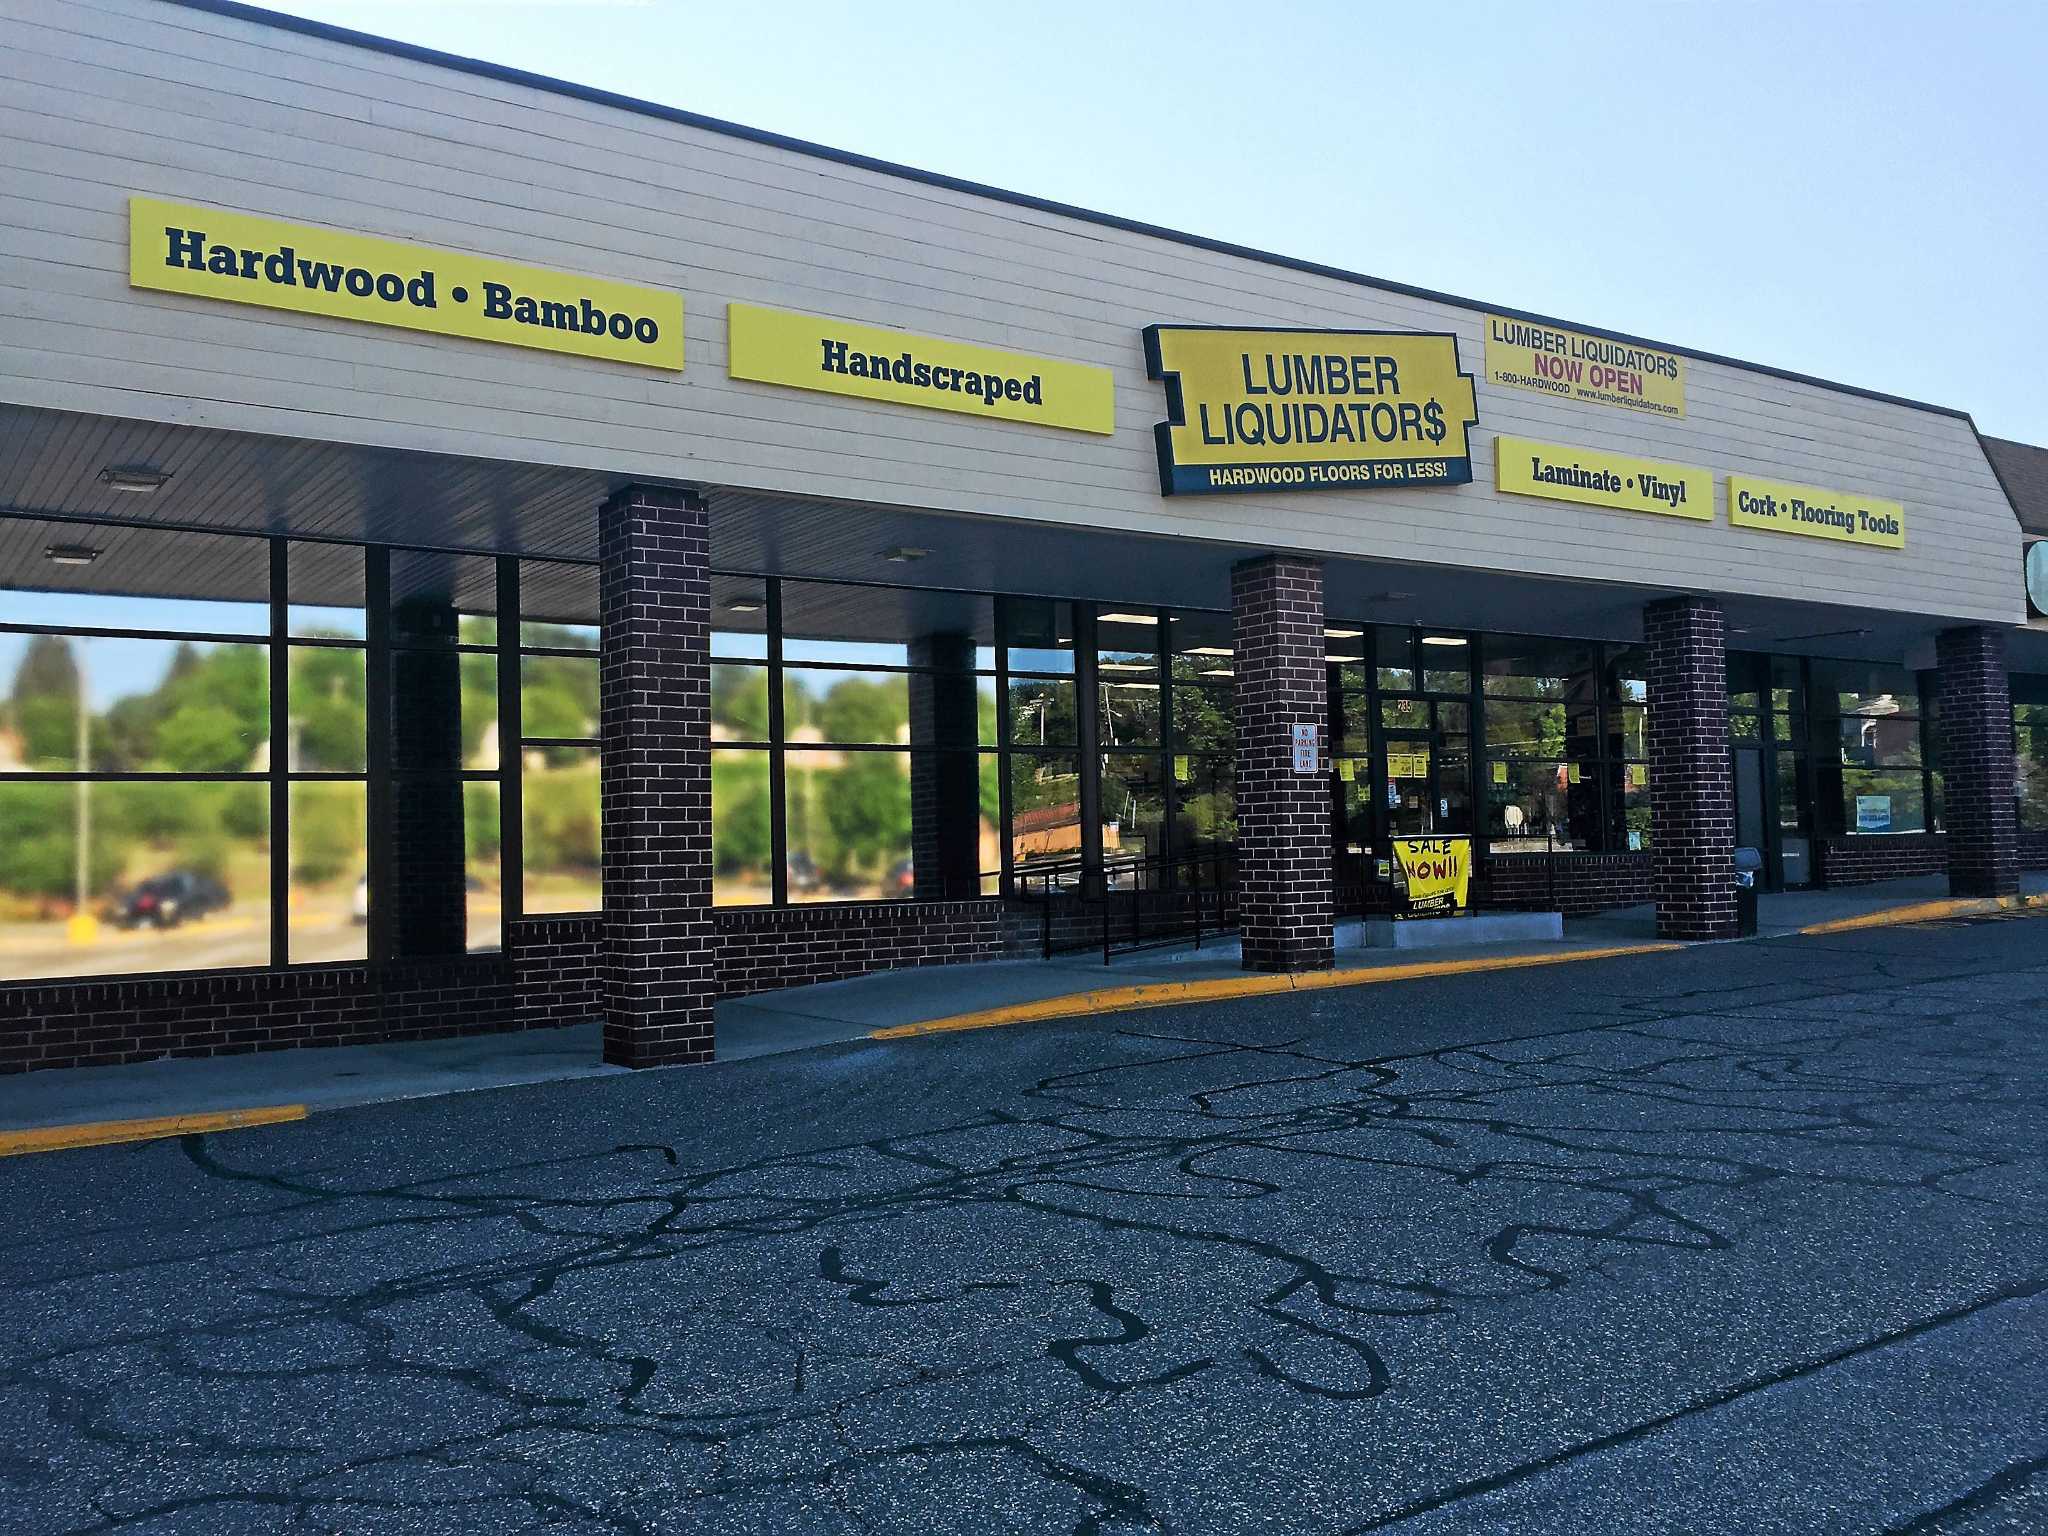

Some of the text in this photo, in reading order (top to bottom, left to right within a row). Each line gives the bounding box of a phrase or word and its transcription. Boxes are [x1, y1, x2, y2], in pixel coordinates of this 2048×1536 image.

[165, 226, 659, 344] Hardwood Bamboo
[1492, 319, 1678, 380] LUMBER LIQUIDATOR$
[821, 339, 1043, 406] Handscraped
[1241, 353, 1400, 396] LUMBER
[1494, 371, 1679, 415] 1-800-HARDWOOD www.lumberliquidators.com
[1534, 352, 1643, 396] NOW OPEN
[1199, 397, 1447, 447] LIQUIDATOR$
[1209, 461, 1448, 486] HARDWOOD FLOORS FOR LESS!
[1531, 456, 1687, 507] Laminate Vinyl
[1738, 490, 1899, 536] Cork Flooring Tools
[1407, 839, 1452, 855] SALE
[1413, 896, 1444, 910] LUMBER
